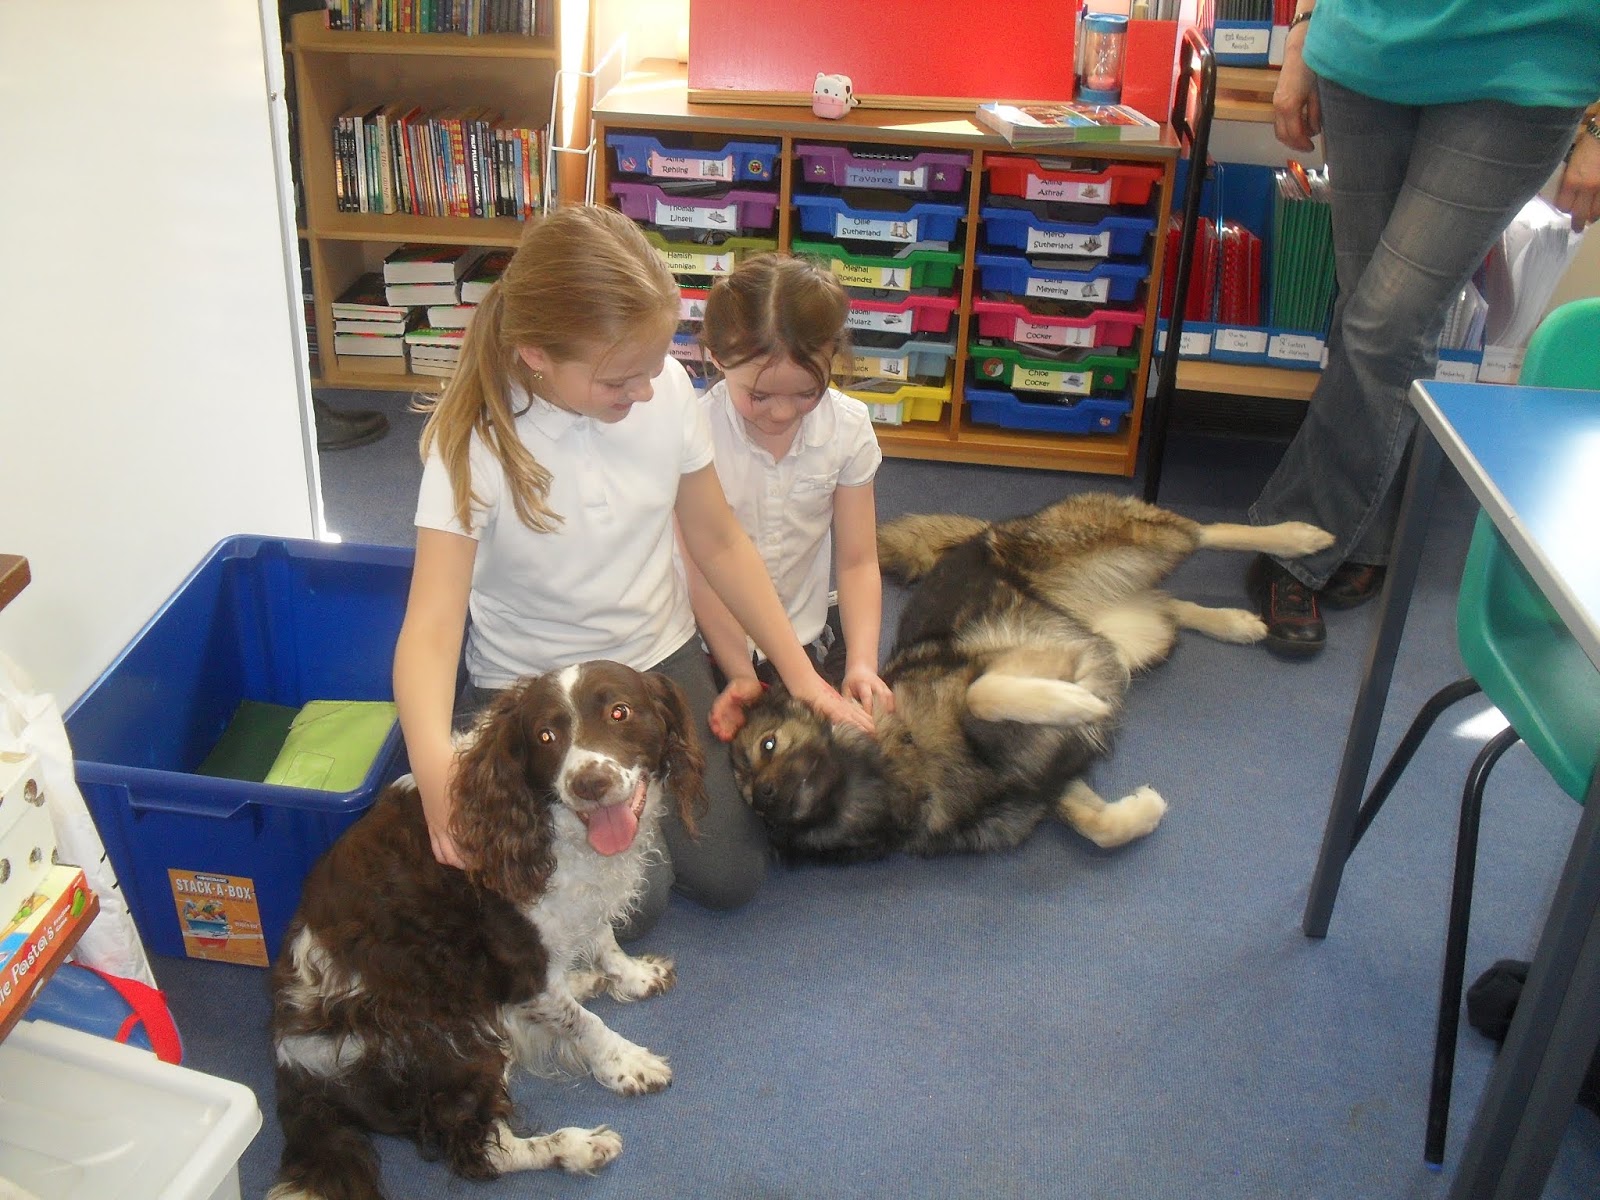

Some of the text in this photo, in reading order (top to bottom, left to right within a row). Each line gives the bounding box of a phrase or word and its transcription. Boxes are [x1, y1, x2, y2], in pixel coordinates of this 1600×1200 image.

[471, 150, 479, 172] PULLMAN
[850, 174, 893, 184] Tavares
[1037, 188, 1064, 198] Ashraf
[669, 205, 695, 213] Thomas
[841, 227, 882, 237] Sutherland
[1033, 240, 1074, 250] Sutherland
[667, 251, 693, 260] Hamish
[1036, 285, 1069, 296] Meyering
[1028, 369, 1049, 377] Chloe
[1024, 379, 1050, 387] Cocker
[11, 926, 54, 986] Pasta's
